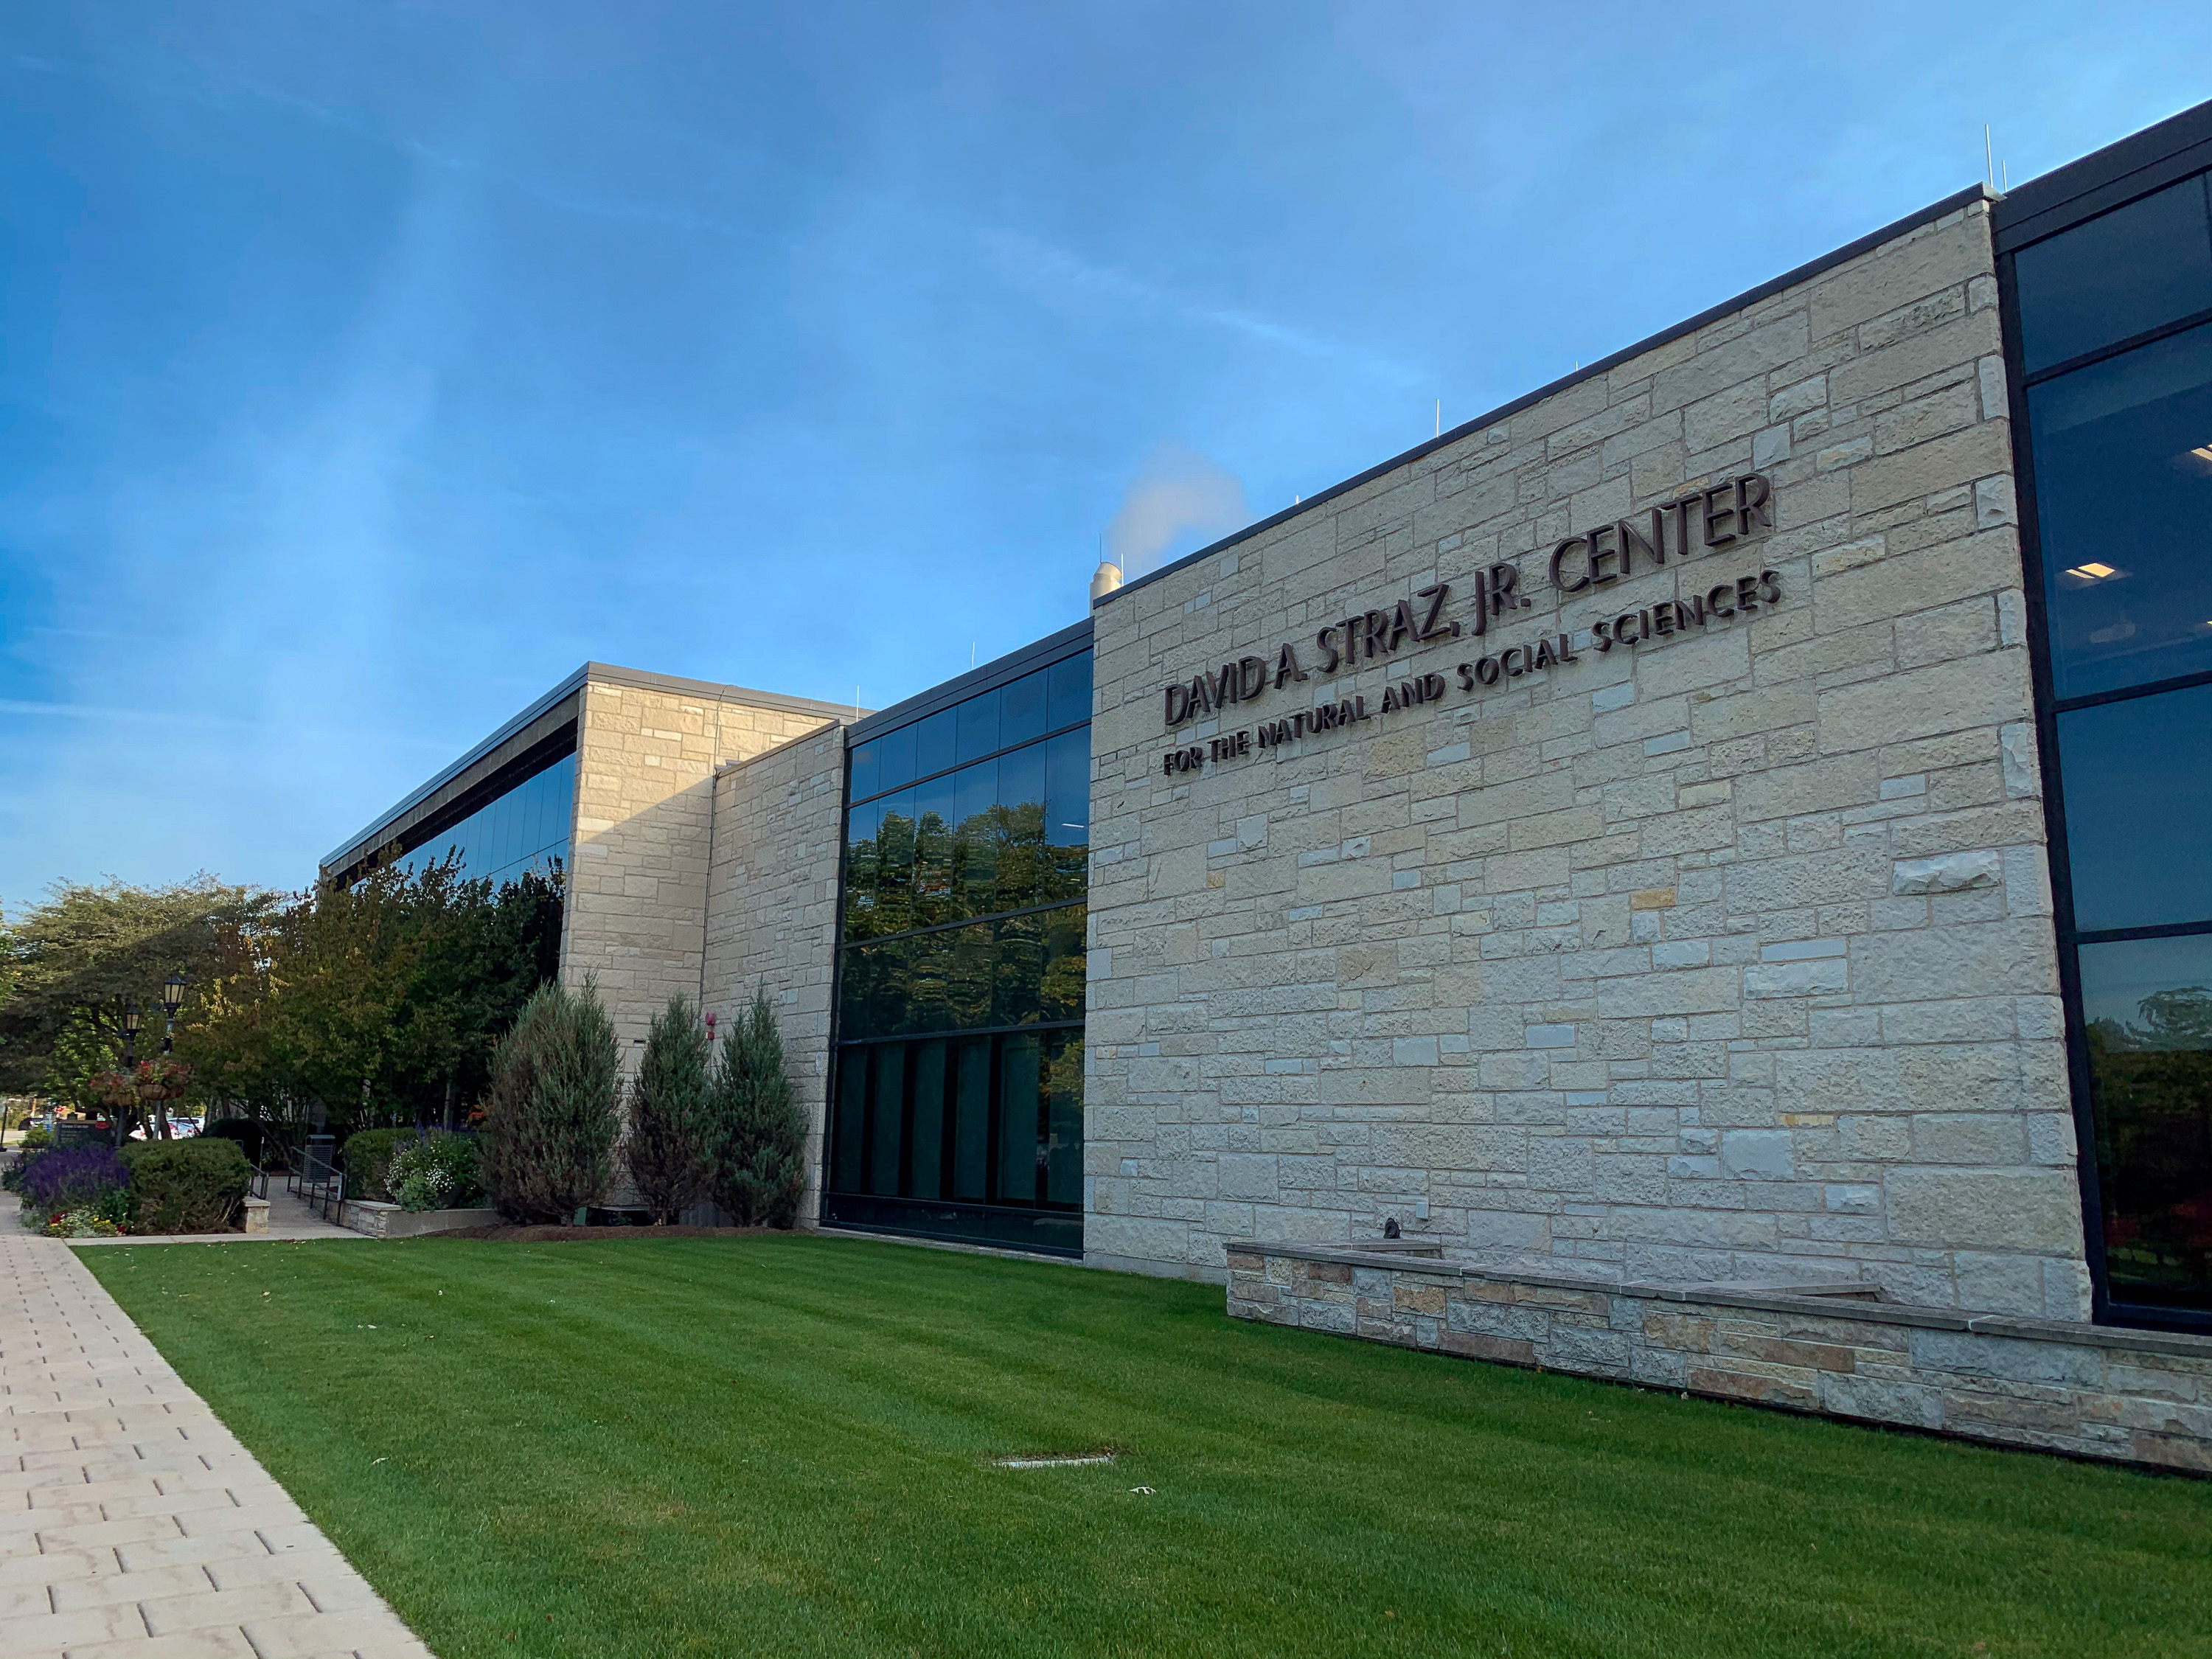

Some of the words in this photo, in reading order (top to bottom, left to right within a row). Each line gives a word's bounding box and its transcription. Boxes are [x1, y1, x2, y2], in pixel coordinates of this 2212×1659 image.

[1164, 747, 1203, 776] FOR
[1207, 731, 1249, 763] THE
[1258, 696, 1371, 748] NATURAL
[1381, 673, 1446, 714] AND
[1457, 633, 1578, 692] SOCIAL
[1593, 570, 1781, 652] SCIENCES
[1165, 655, 1267, 726] DAVID
[1273, 643, 1309, 689] A.
[1472, 562, 1531, 636] JR.
[1549, 473, 1773, 592] CENTER
